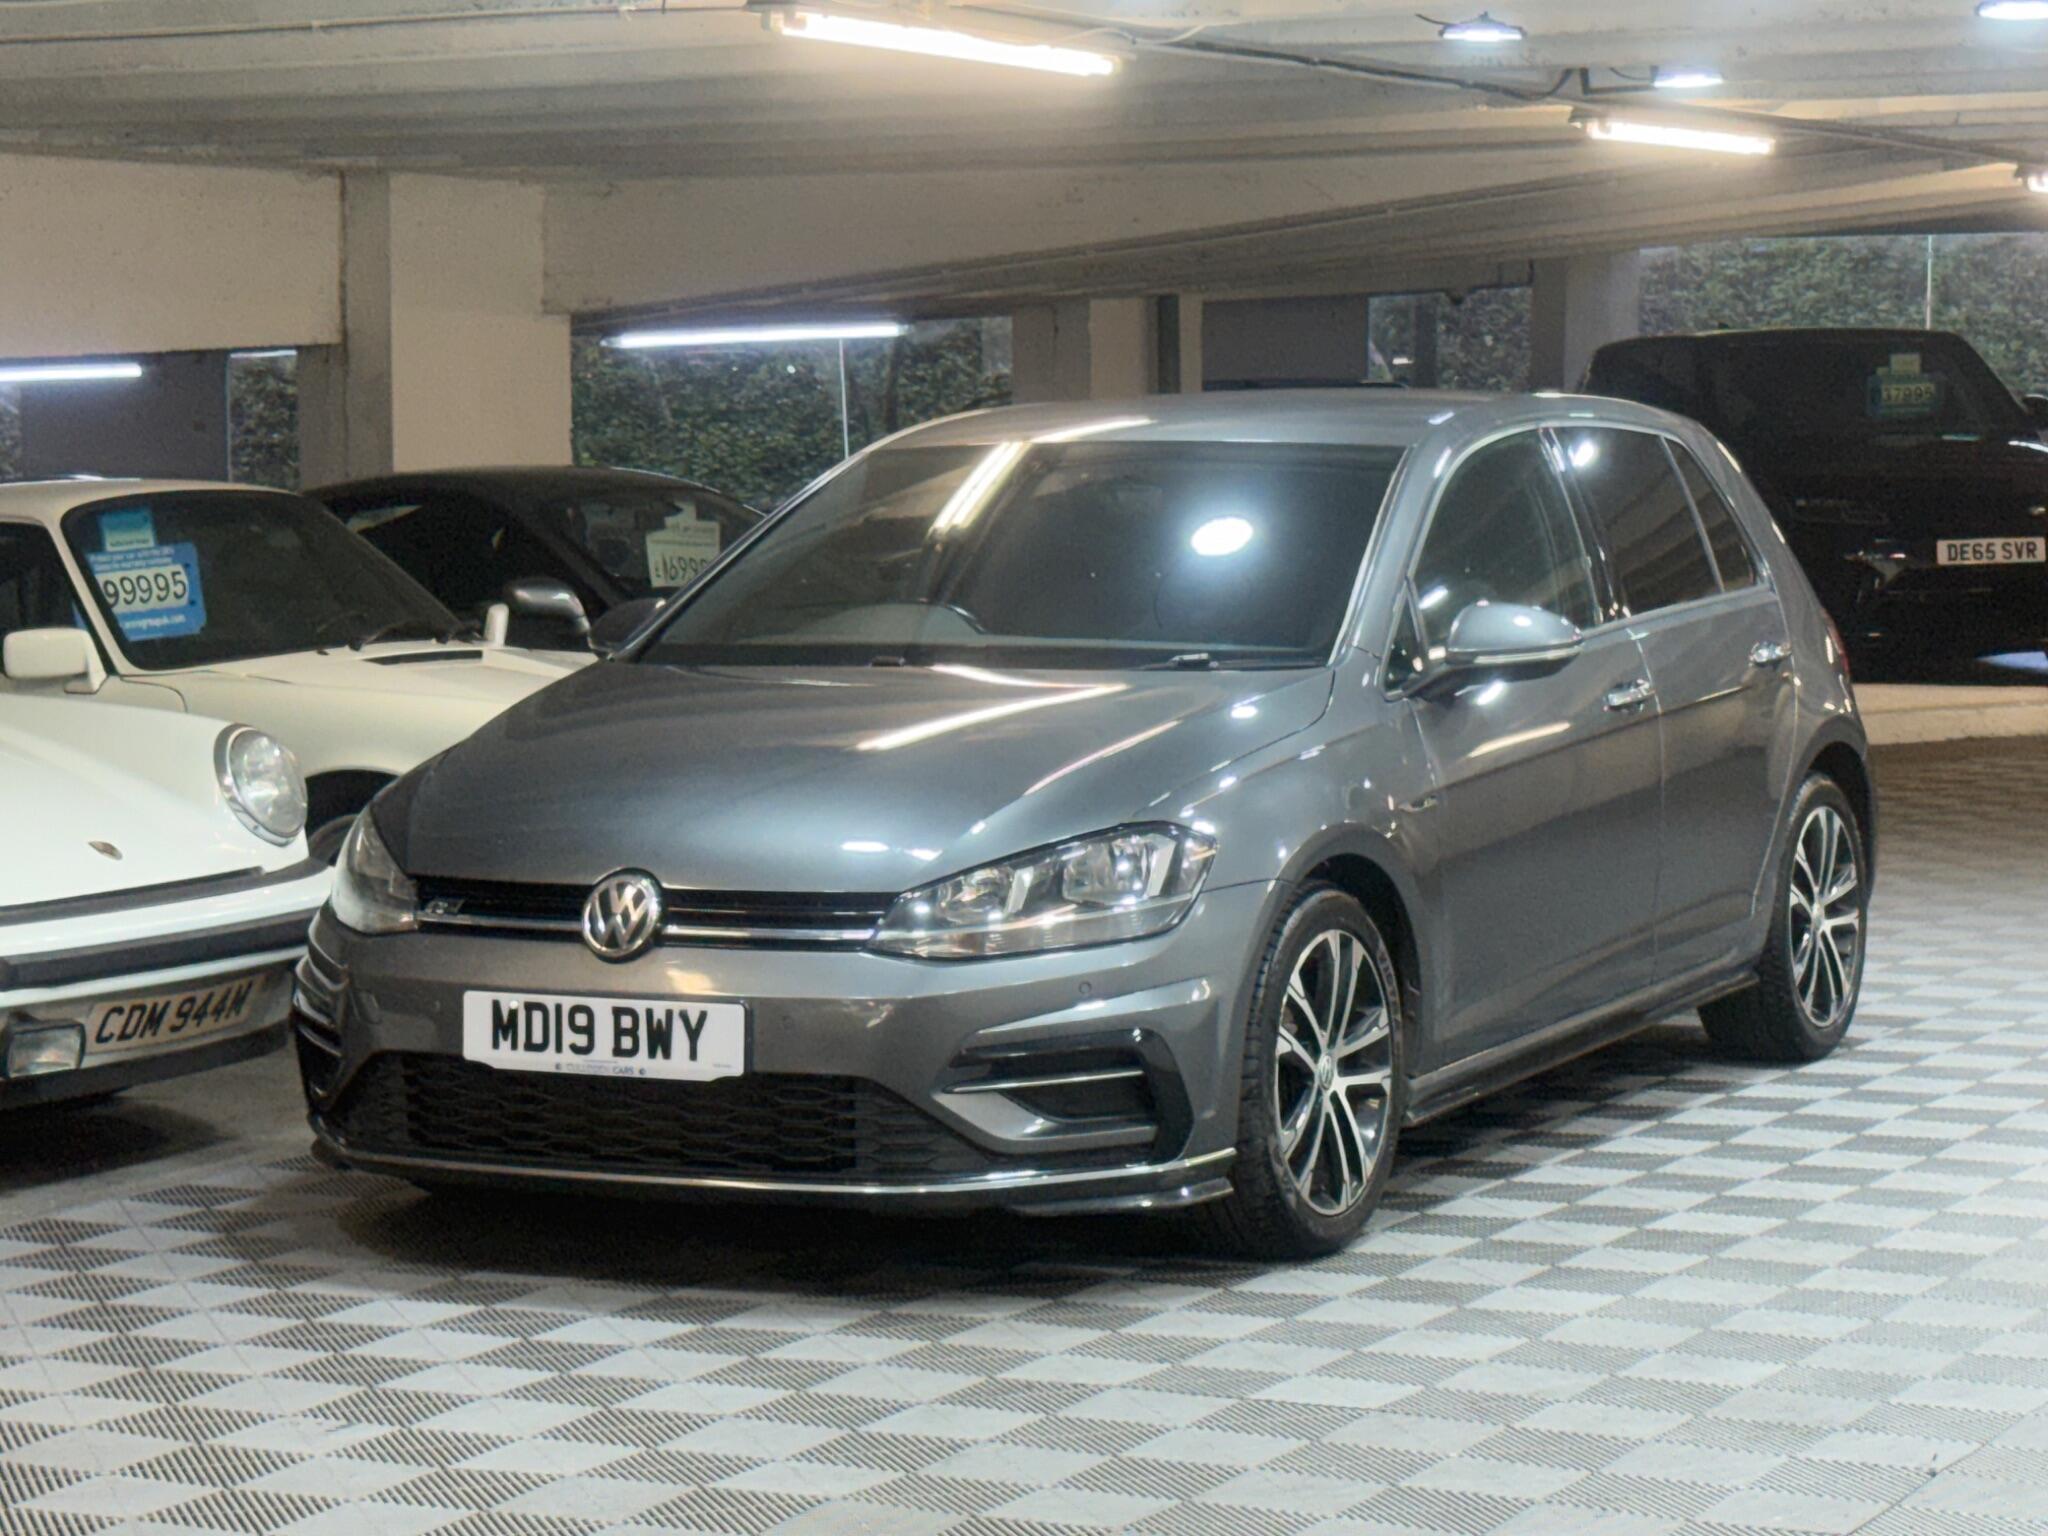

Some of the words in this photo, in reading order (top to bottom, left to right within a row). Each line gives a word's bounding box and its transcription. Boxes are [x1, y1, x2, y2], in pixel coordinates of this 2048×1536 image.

[1946, 543, 1996, 561] DE65
[2001, 541, 2038, 560] SVR
[104, 572, 187, 608] 99995
[95, 1000, 172, 1044] CDM
[491, 998, 596, 1056] MD19
[611, 1006, 708, 1062] BWY
